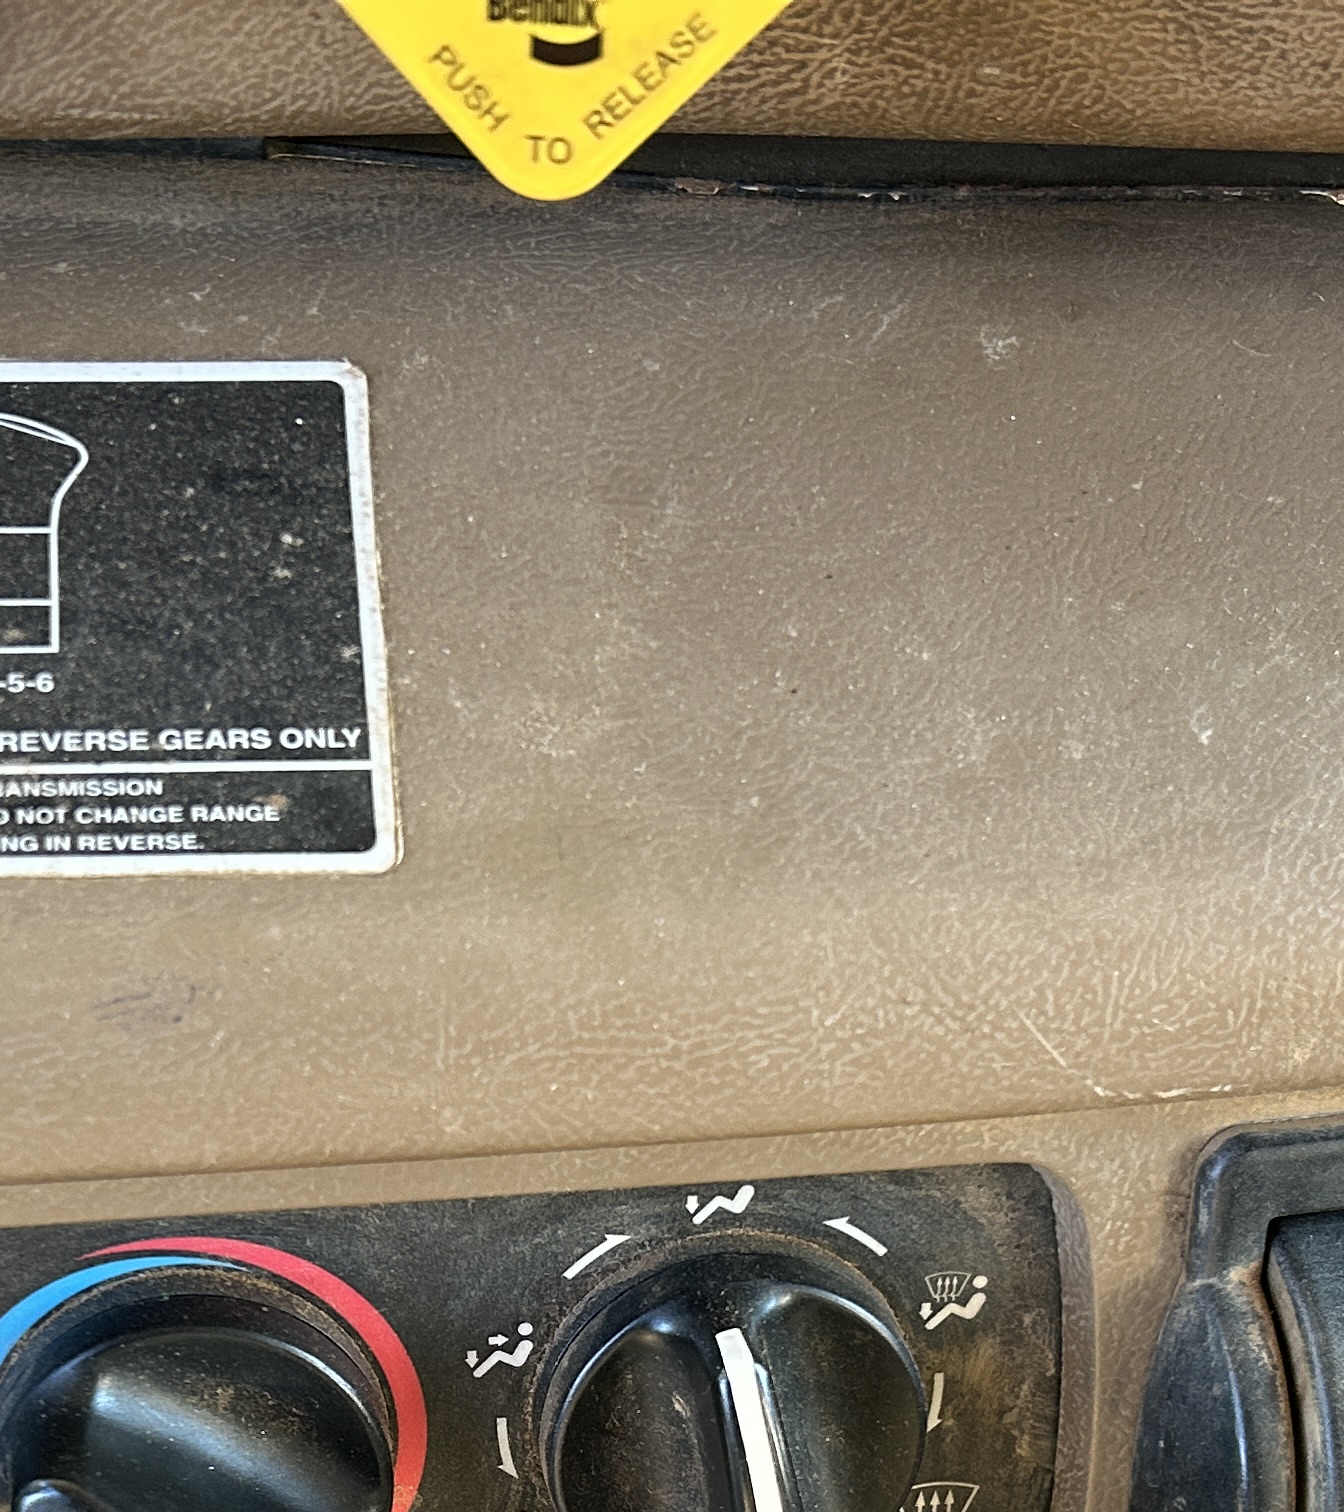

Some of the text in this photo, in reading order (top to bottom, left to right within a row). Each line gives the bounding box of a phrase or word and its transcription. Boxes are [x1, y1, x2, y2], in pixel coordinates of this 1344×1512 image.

[428, 11, 718, 164] PUSH TO RELEASE
[158, 728, 272, 751] GEARS
[280, 727, 362, 750] ONLY
[16, 807, 67, 826] NOT
[74, 805, 185, 825] CHANGE
[191, 803, 280, 823] RANGE
[46, 834, 73, 853] IN
[78, 831, 206, 852] REVERSE.
